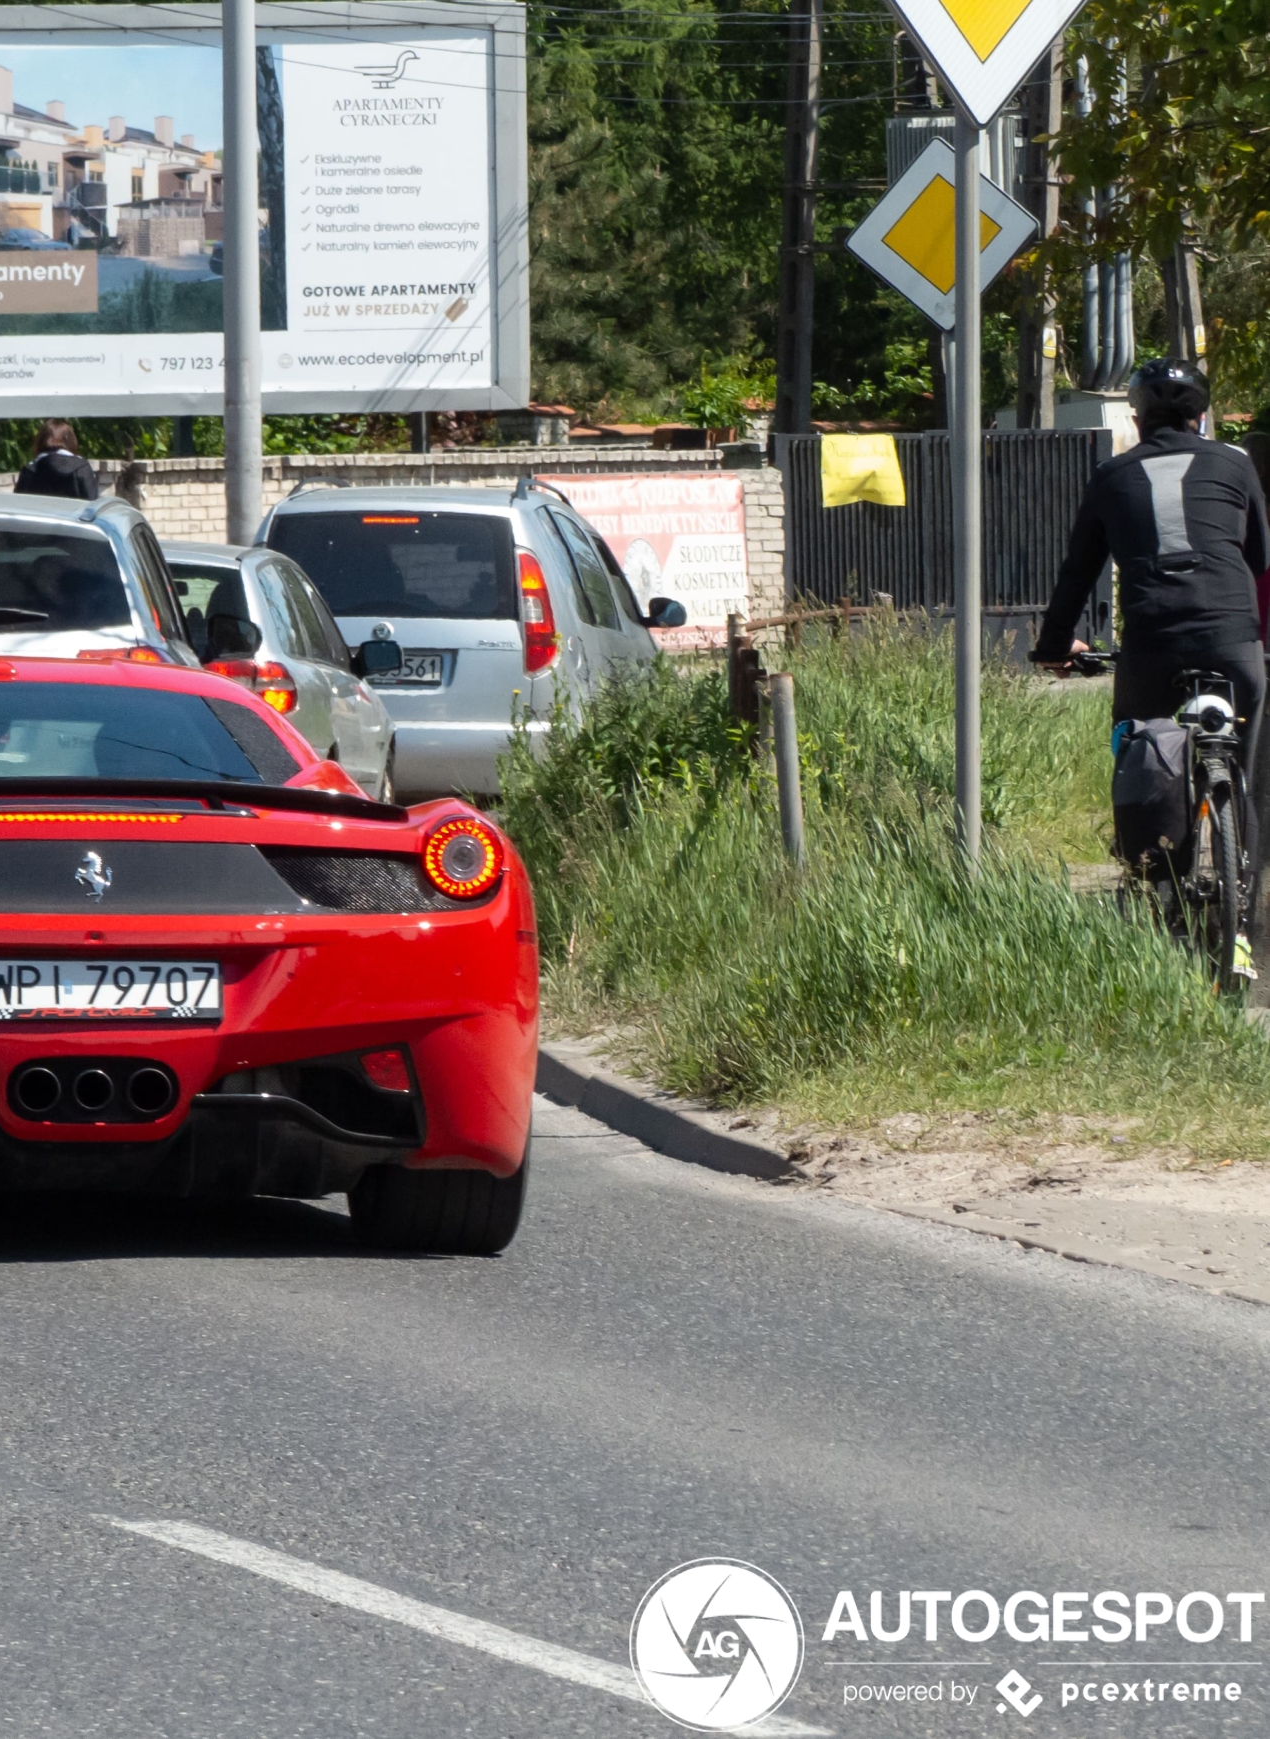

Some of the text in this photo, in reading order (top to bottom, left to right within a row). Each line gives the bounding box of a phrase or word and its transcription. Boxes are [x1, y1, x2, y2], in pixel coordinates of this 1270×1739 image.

[332, 97, 445, 111] APARTAMENTY
[340, 113, 437, 127] CYRANECZKI
[315, 154, 382, 167] Ekskluzywne
[321, 166, 380, 177] kameralne
[384, 165, 423, 176] osiedle
[315, 185, 422, 197] Duże zielone tarasy
[316, 204, 359, 217] Ogródki
[316, 220, 480, 233] Naturalne drewno elewacyjne
[316, 240, 478, 253] Naturalny kamień elewacyjny
[303, 283, 476, 298] GOTOWE APARTAMENTY
[303, 300, 439, 317] JUŻ W SPRZEDAŻY
[160, 357, 185, 371] 797
[191, 356, 213, 370] 123
[298, 350, 484, 367] www.ecodevelopment.pl
[681, 544, 743, 563] SŁODYCZE
[674, 571, 745, 591] KOSMETYKI
[85, 965, 215, 1008] 79707
